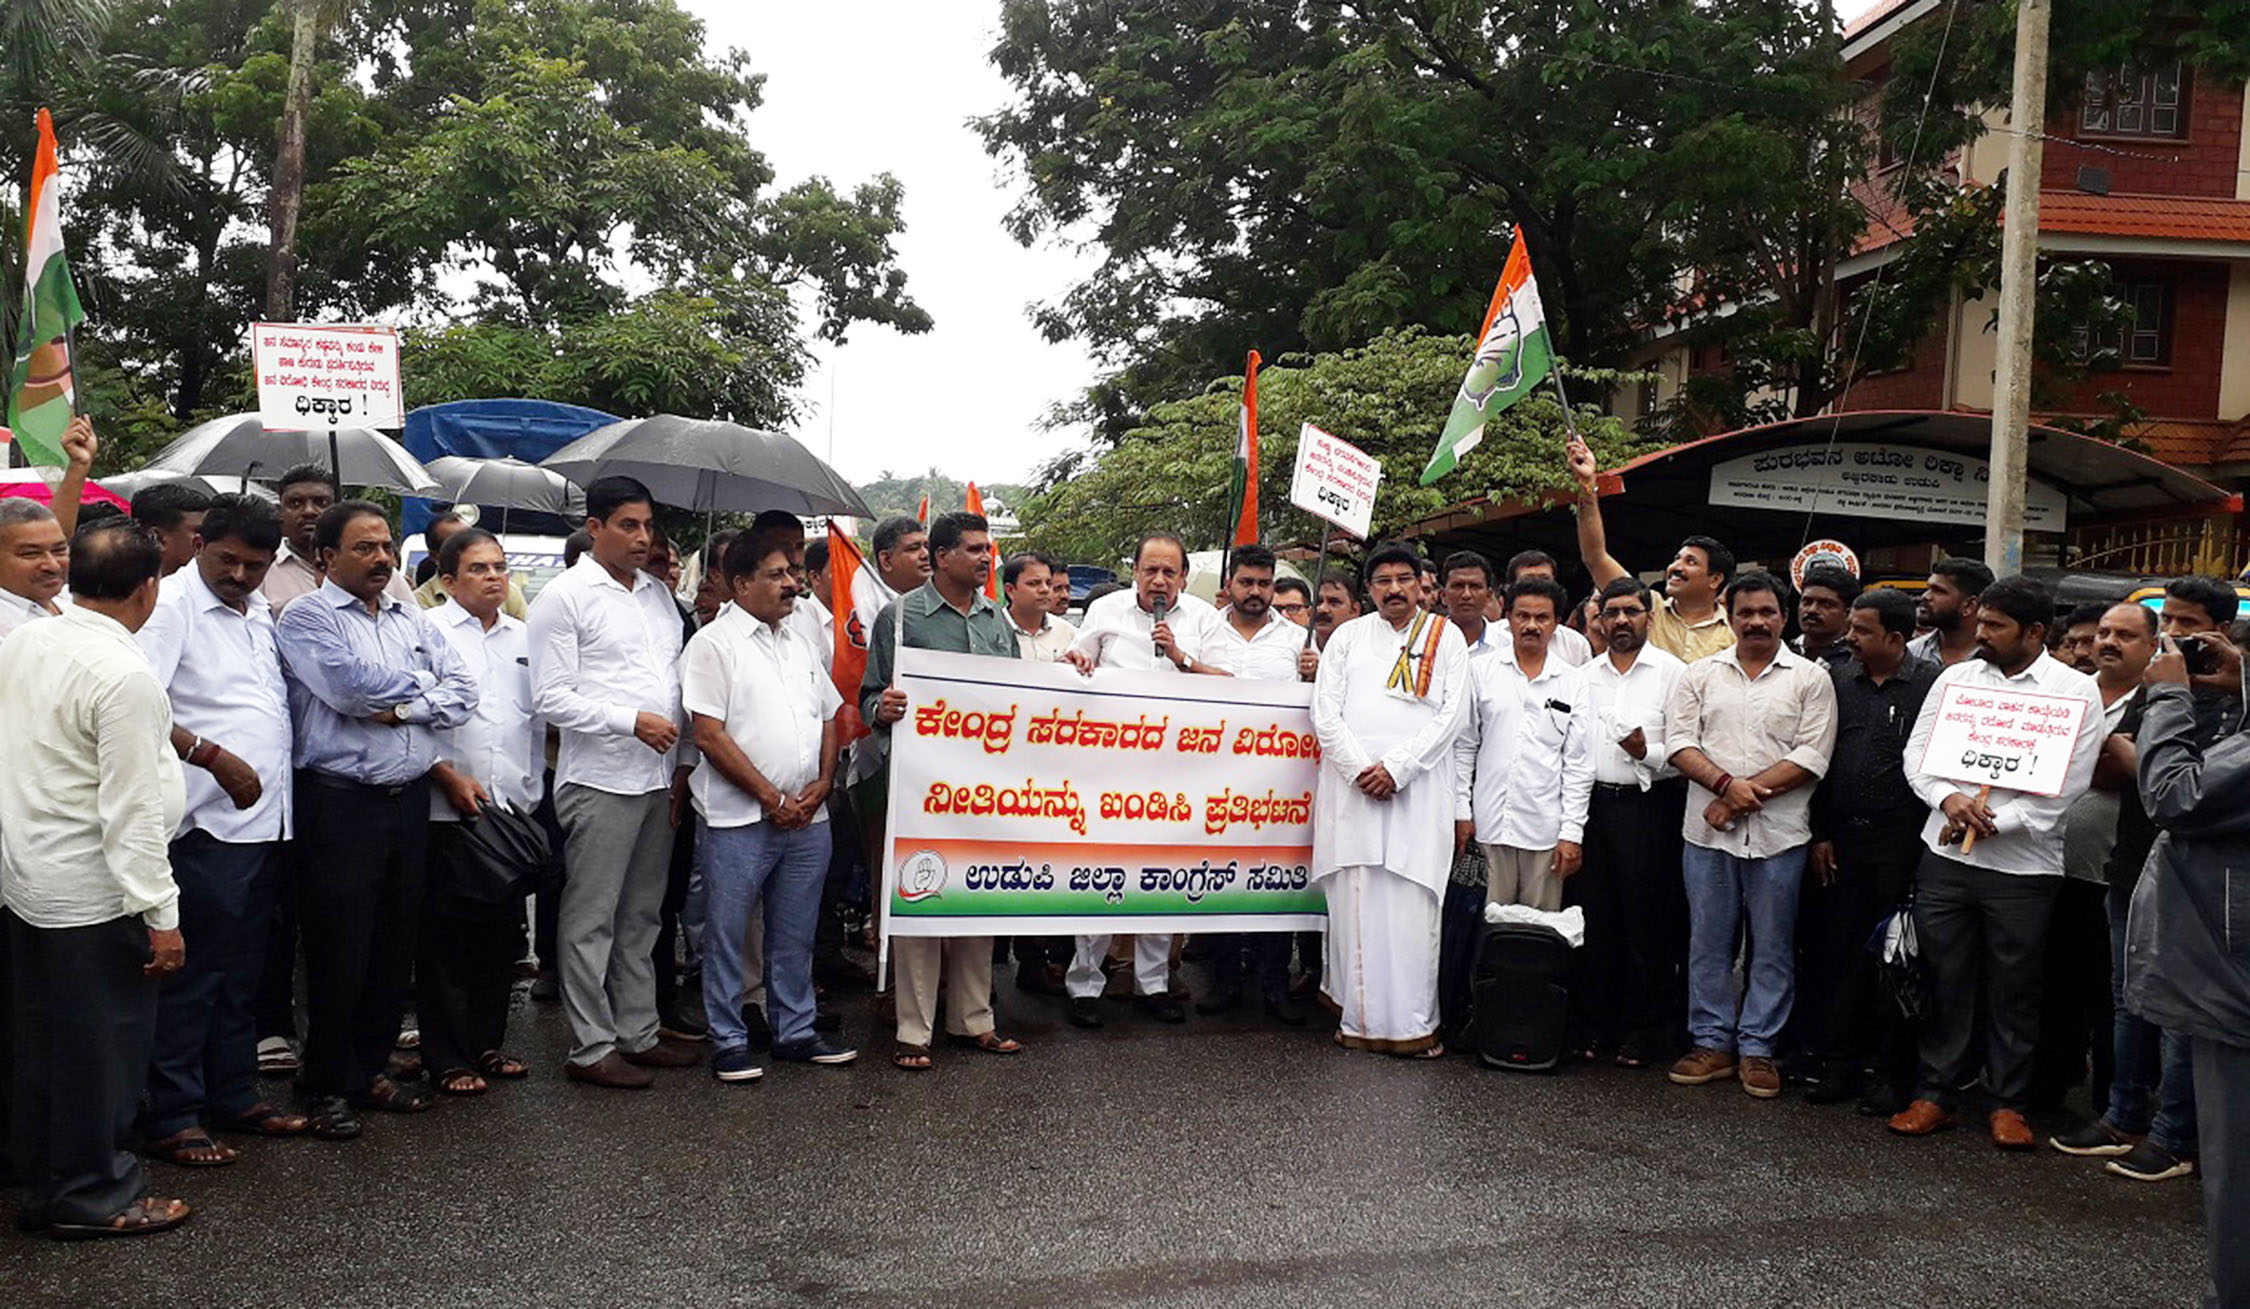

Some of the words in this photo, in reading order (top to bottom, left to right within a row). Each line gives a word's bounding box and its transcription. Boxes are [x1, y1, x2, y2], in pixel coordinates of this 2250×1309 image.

[295, 393, 352, 424] ಧಿಕ್ಕಾರ
[1754, 447, 1844, 473] ಪುರಭವನ
[914, 697, 1018, 754] ಕೇಂದ್ರ
[1026, 706, 1169, 752] ಸರಕಾರದ
[1176, 718, 1225, 754] ಜನ
[1960, 749, 2022, 780] ಧಿಕ್ಕಾರ
[923, 778, 1088, 836] ನೀತಿಯನ್ನು
[1099, 788, 1192, 823] ಖಂಡಿಸಿ
[1204, 786, 1313, 835] ಪ್ರತಿಭಟನೆ
[964, 857, 1055, 892] ಉಡುಪಿ
[1069, 861, 1127, 904] ಜಿಲ್ಲಾ
[1139, 860, 1237, 903] ಕಾಂಗ್ರೆಸ್
[1246, 857, 1308, 893] ಸಮಿತಿ
